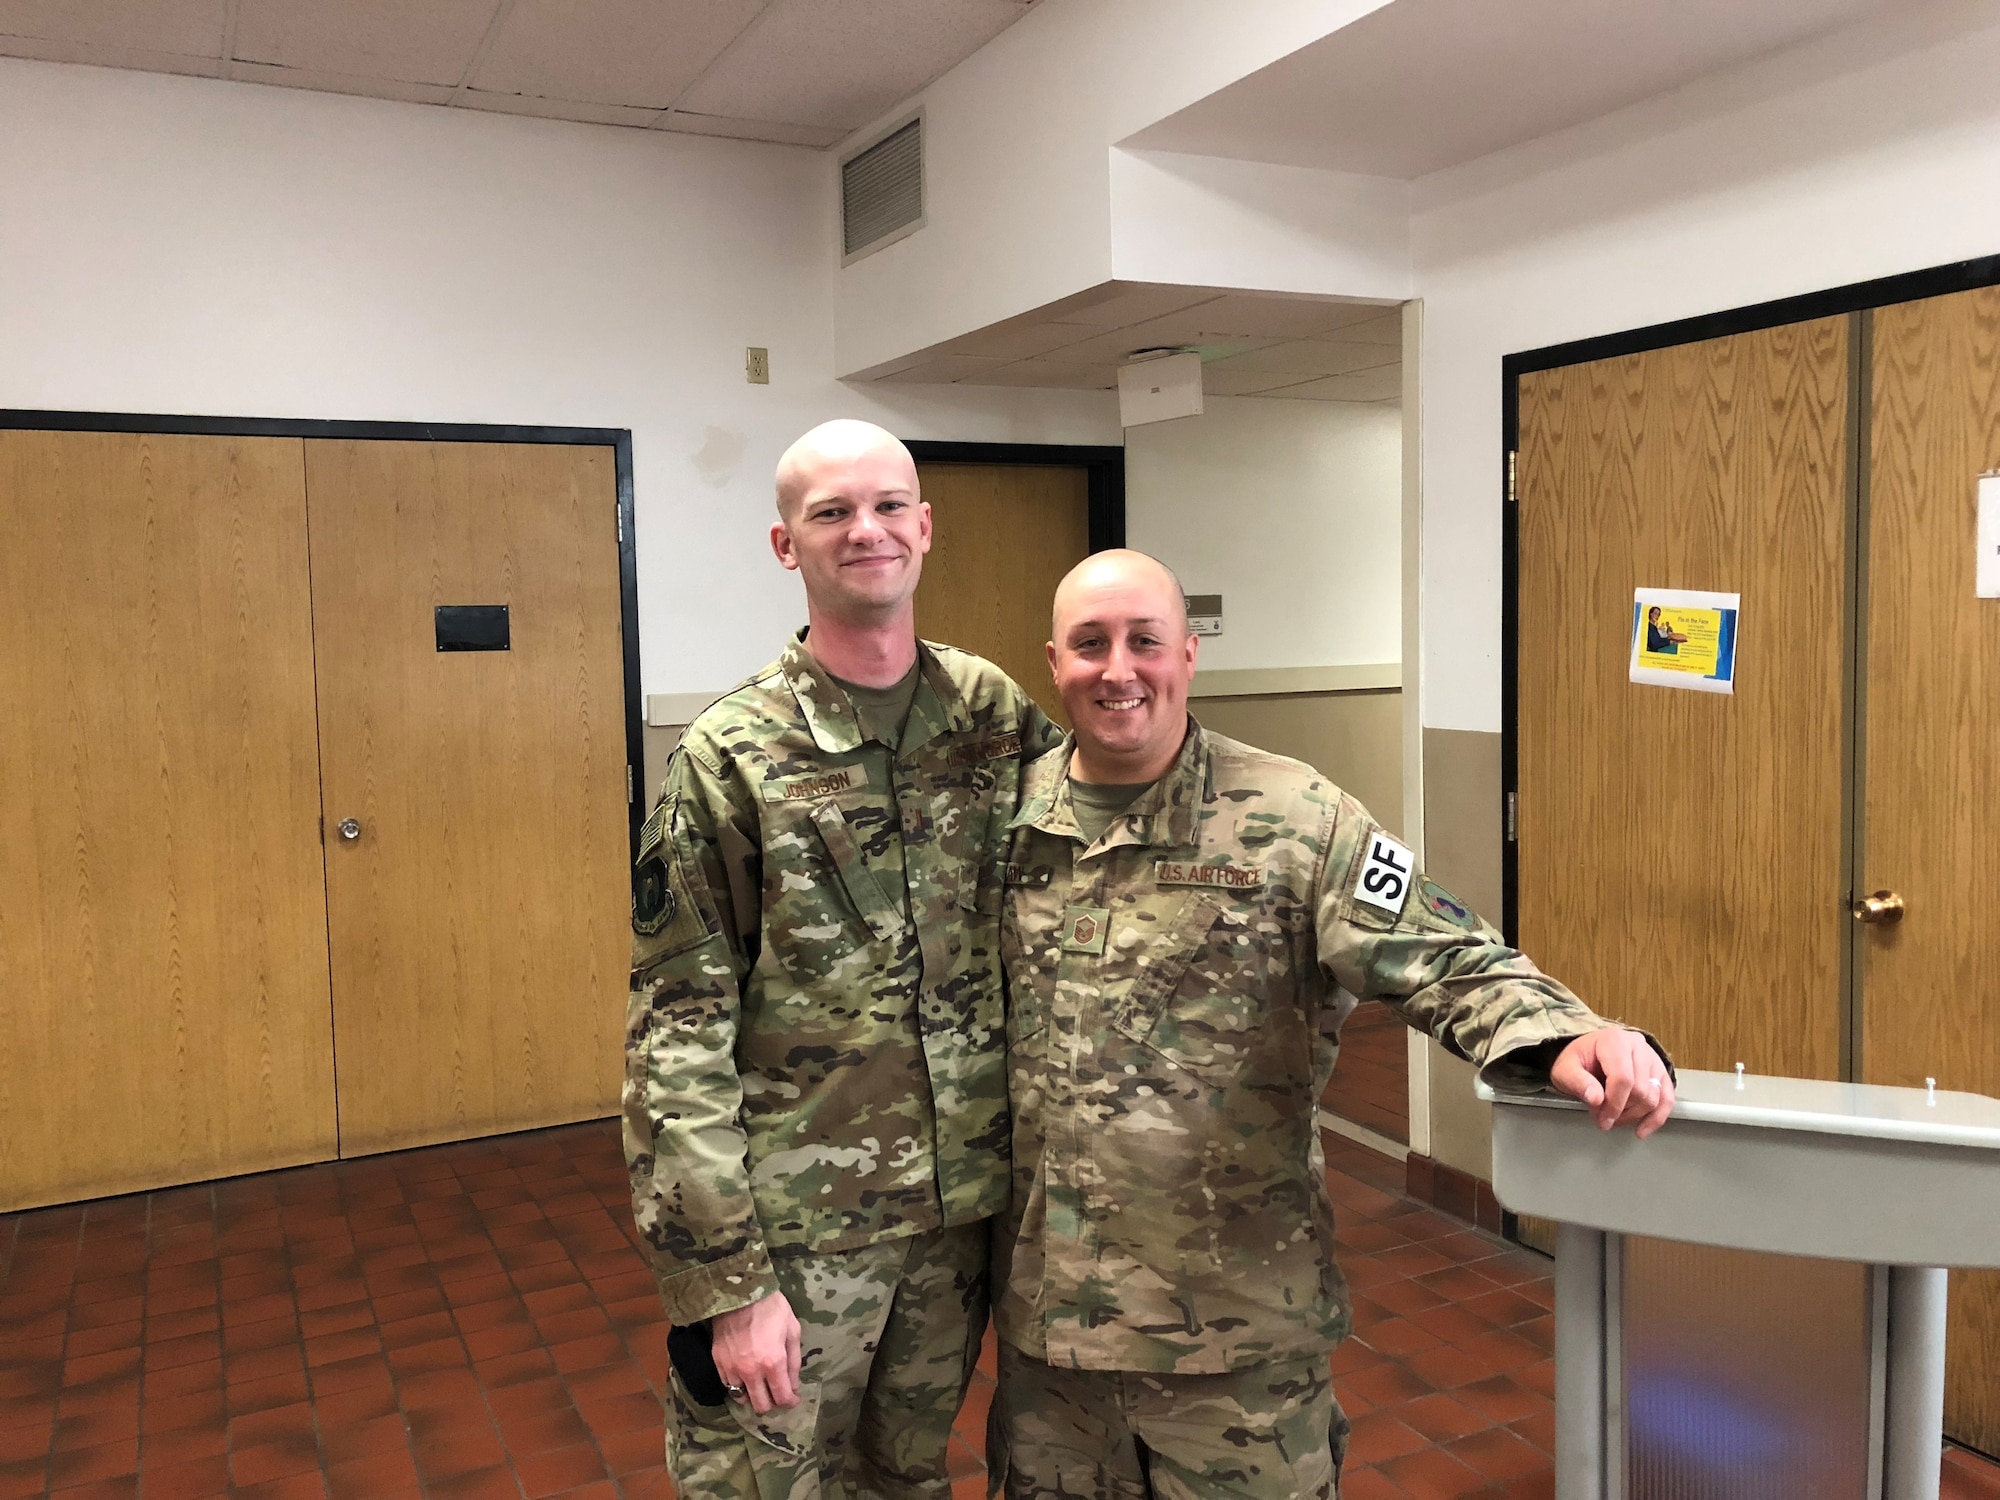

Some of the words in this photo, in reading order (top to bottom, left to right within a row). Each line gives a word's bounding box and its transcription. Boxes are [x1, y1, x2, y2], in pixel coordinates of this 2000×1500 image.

[784, 771, 851, 798] JOHNSON
[1159, 863, 1185, 881] U.S.
[1188, 865, 1214, 883] AIR
[1216, 866, 1262, 887] FORCE
[1364, 841, 1407, 900] SF
